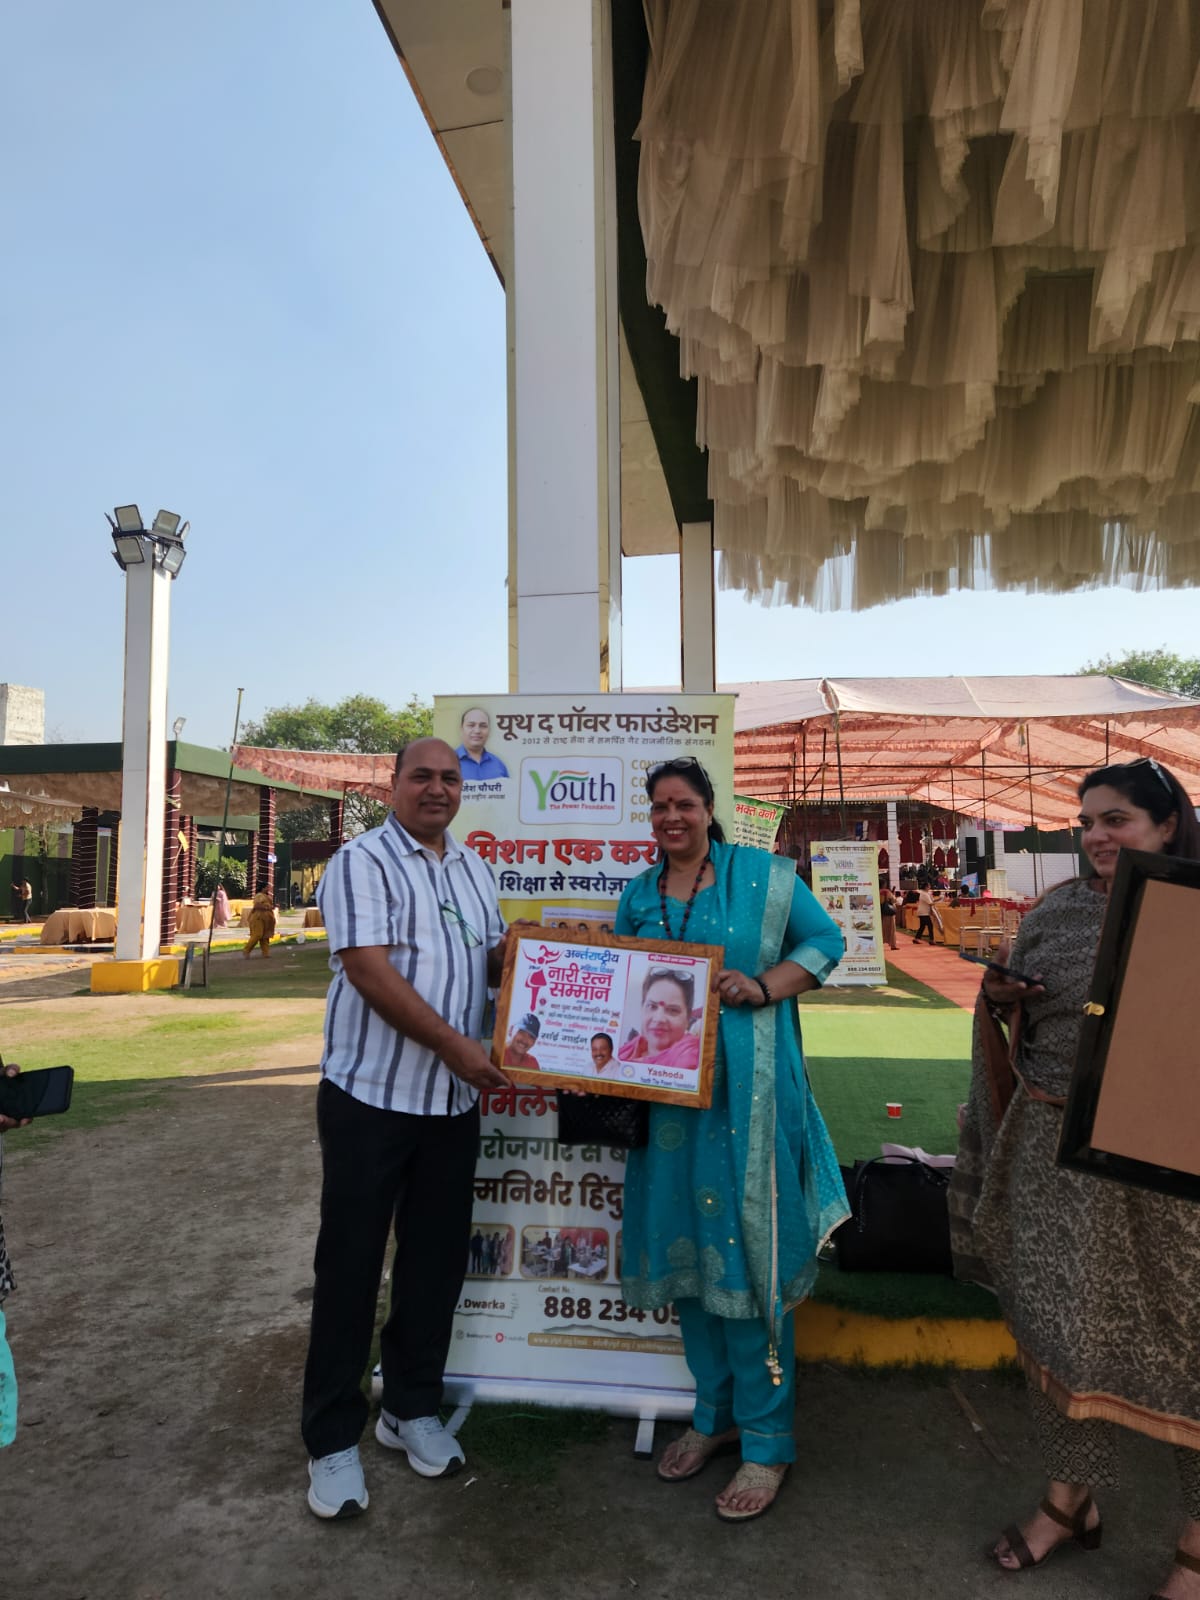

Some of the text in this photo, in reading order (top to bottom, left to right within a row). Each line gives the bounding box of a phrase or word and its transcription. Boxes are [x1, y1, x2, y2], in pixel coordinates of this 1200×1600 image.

[496, 706, 719, 741] यूथ द पॉवर फाउंडेशन
[529, 770, 616, 811] Youth
[464, 830, 549, 865] मिशन
[552, 839, 605, 865] एक
[499, 870, 546, 895] शिक्षा
[549, 871, 565, 892] से
[548, 962, 613, 987] नारी रत्न
[549, 982, 611, 1003] सम्मान
[647, 1067, 684, 1080] Yashoda
[464, 1298, 506, 1310] Dwarka
[544, 1295, 592, 1320] 888
[598, 1298, 646, 1323] 234
